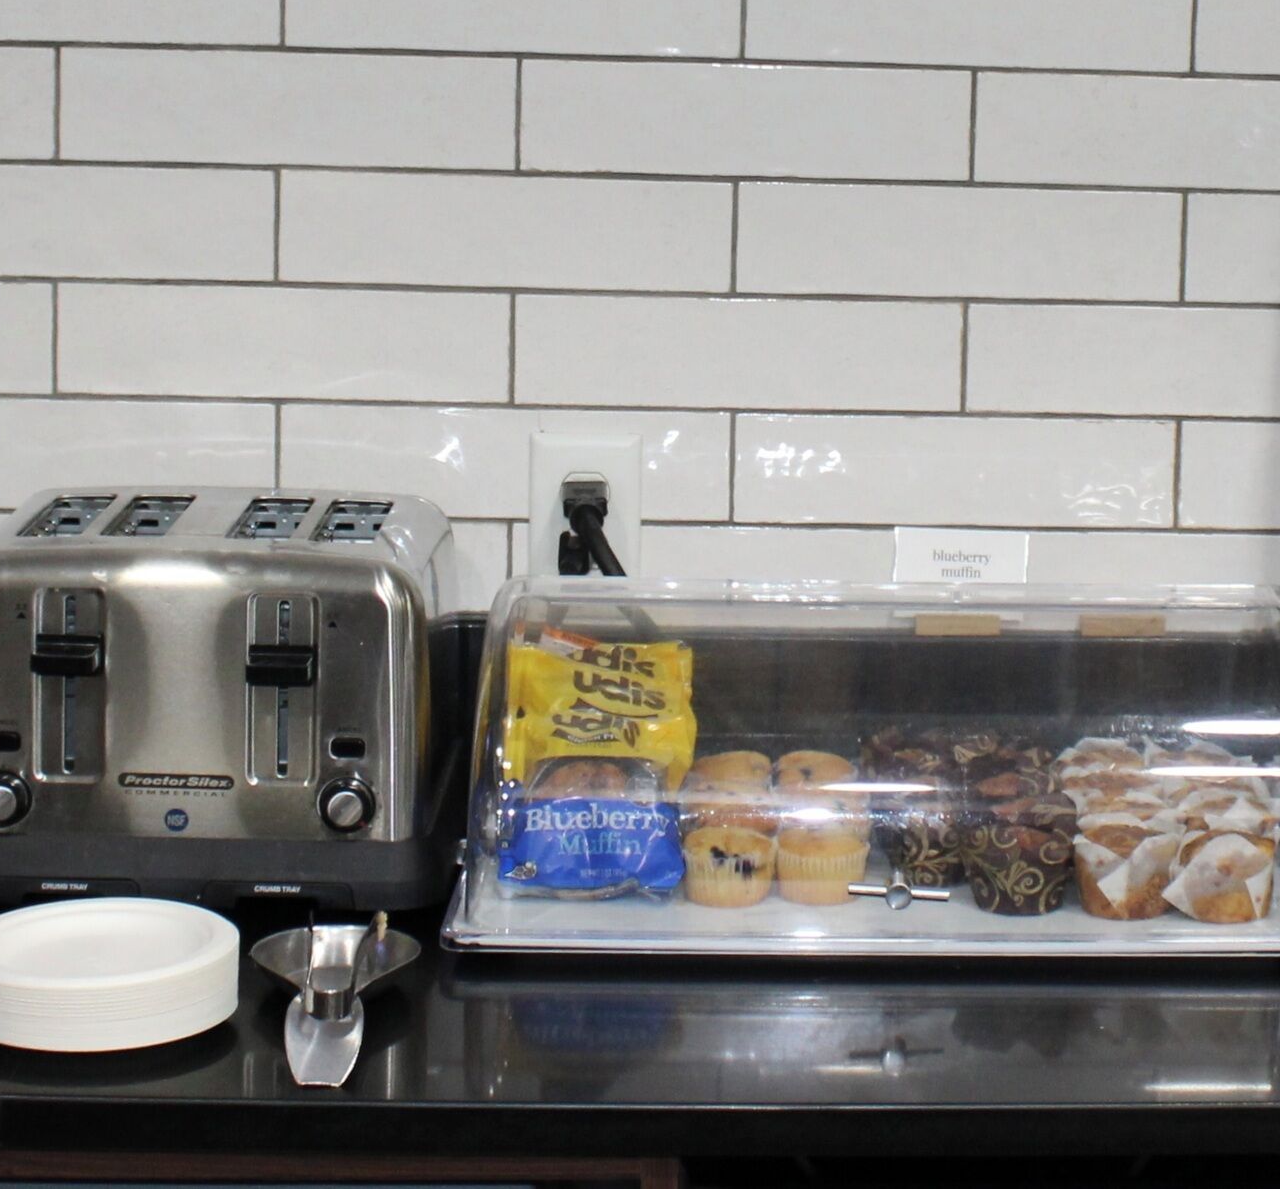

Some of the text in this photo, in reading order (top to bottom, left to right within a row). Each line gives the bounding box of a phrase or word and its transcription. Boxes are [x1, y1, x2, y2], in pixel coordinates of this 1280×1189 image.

[933, 550, 991, 565] blueberry
[941, 567, 981, 579] muffin
[167, 814, 186, 826] NSF
[525, 803, 669, 832] Blueberry
[558, 830, 642, 856] Muffin
